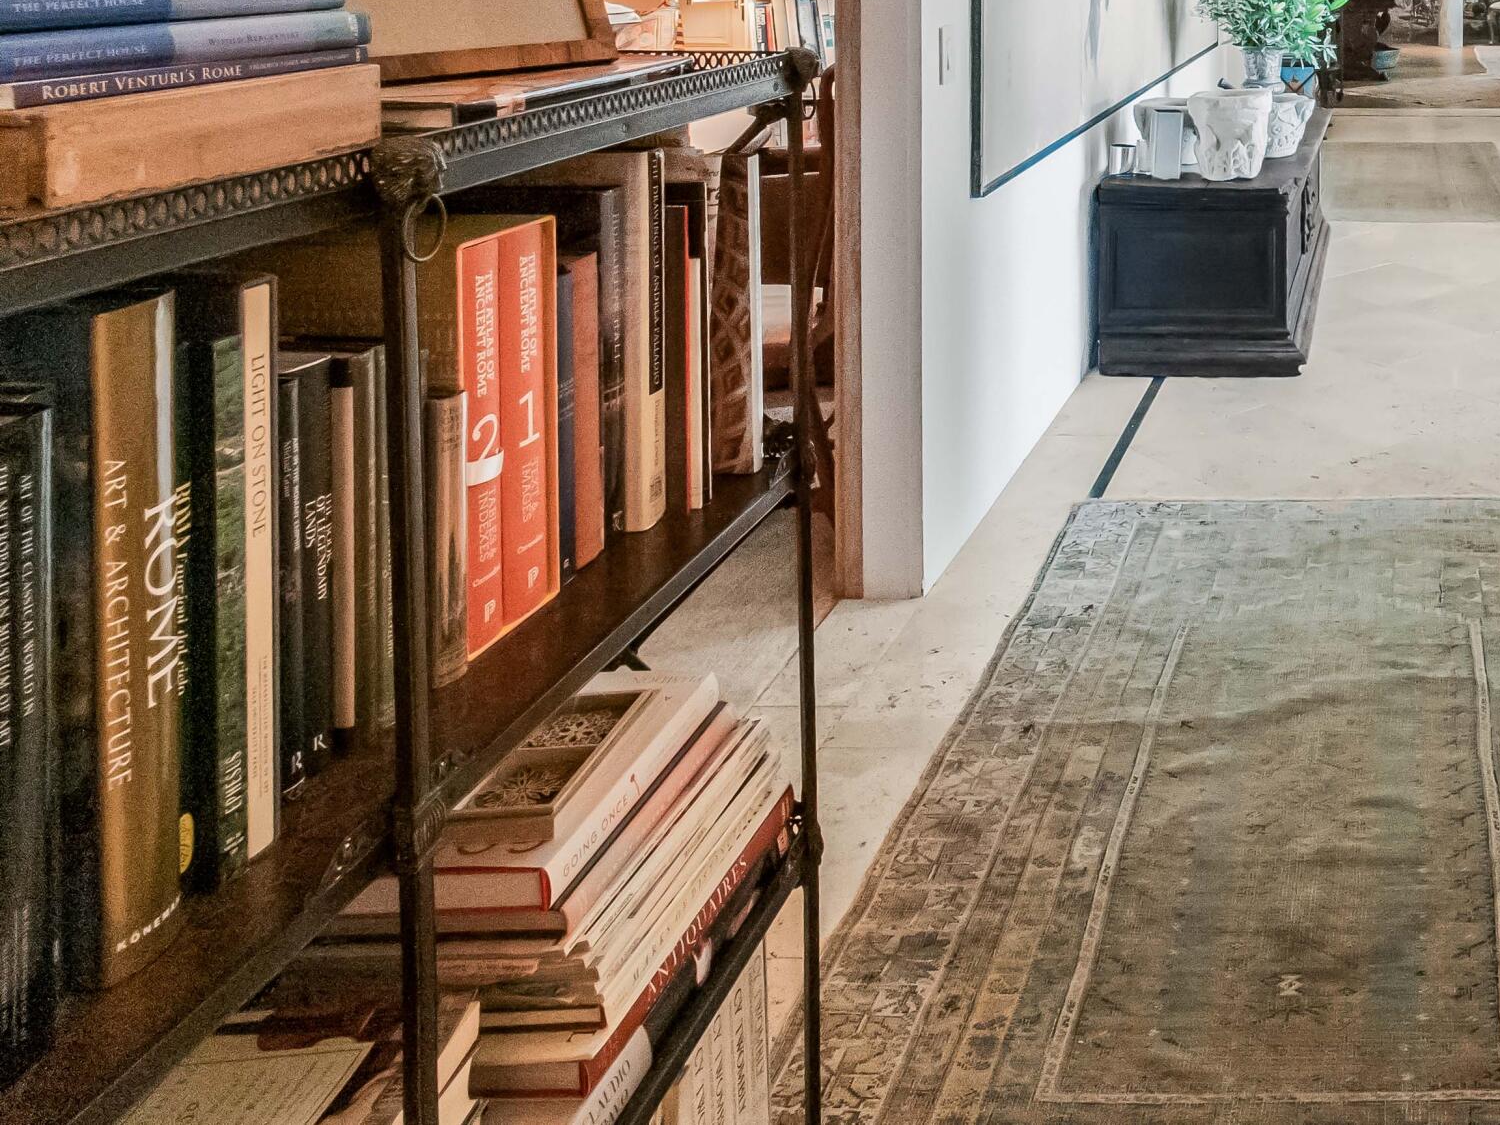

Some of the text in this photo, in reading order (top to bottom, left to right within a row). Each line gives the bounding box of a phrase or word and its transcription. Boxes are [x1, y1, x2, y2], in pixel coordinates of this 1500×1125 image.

[12, 2, 40, 13] THE
[12, 55, 42, 67] THE
[46, 49, 101, 63] PERFECT
[42, 64, 242, 100] ROBERT VENTURI'S ROME
[652, 185, 660, 251] DRAWINGS
[485, 269, 496, 382] THE ATLAS OF
[519, 254, 530, 374] ANCIENT ROME
[528, 252, 537, 357] THE ATLAS OF
[653, 275, 661, 325] ANDREA
[475, 274, 488, 398] ANCIENT ROME
[653, 327, 661, 386] PALLADIO
[251, 353, 267, 539] LIGHT ON STONE
[518, 390, 540, 449] 1
[521, 462, 532, 524] IMAGES
[529, 458, 540, 499] TEXT
[304, 499, 317, 549] LANDS
[316, 494, 328, 601] OF LEGENDARY
[478, 490, 490, 563] INDEXES
[486, 487, 498, 545] TABLES
[20, 474, 36, 718] ART OF THE CLASSICAL WORLD IN
[103, 458, 132, 792] ART & ARCHITECTURE
[142, 492, 181, 710] ROME
[223, 750, 242, 815] EPHESUS
[563, 794, 629, 877] GOING ONCE
[713, 1014, 723, 1042] CY
[753, 955, 765, 1077] CY TWOMBLY
[694, 1047, 704, 1076] CY
[733, 988, 748, 1115] CY TWOMBLY
